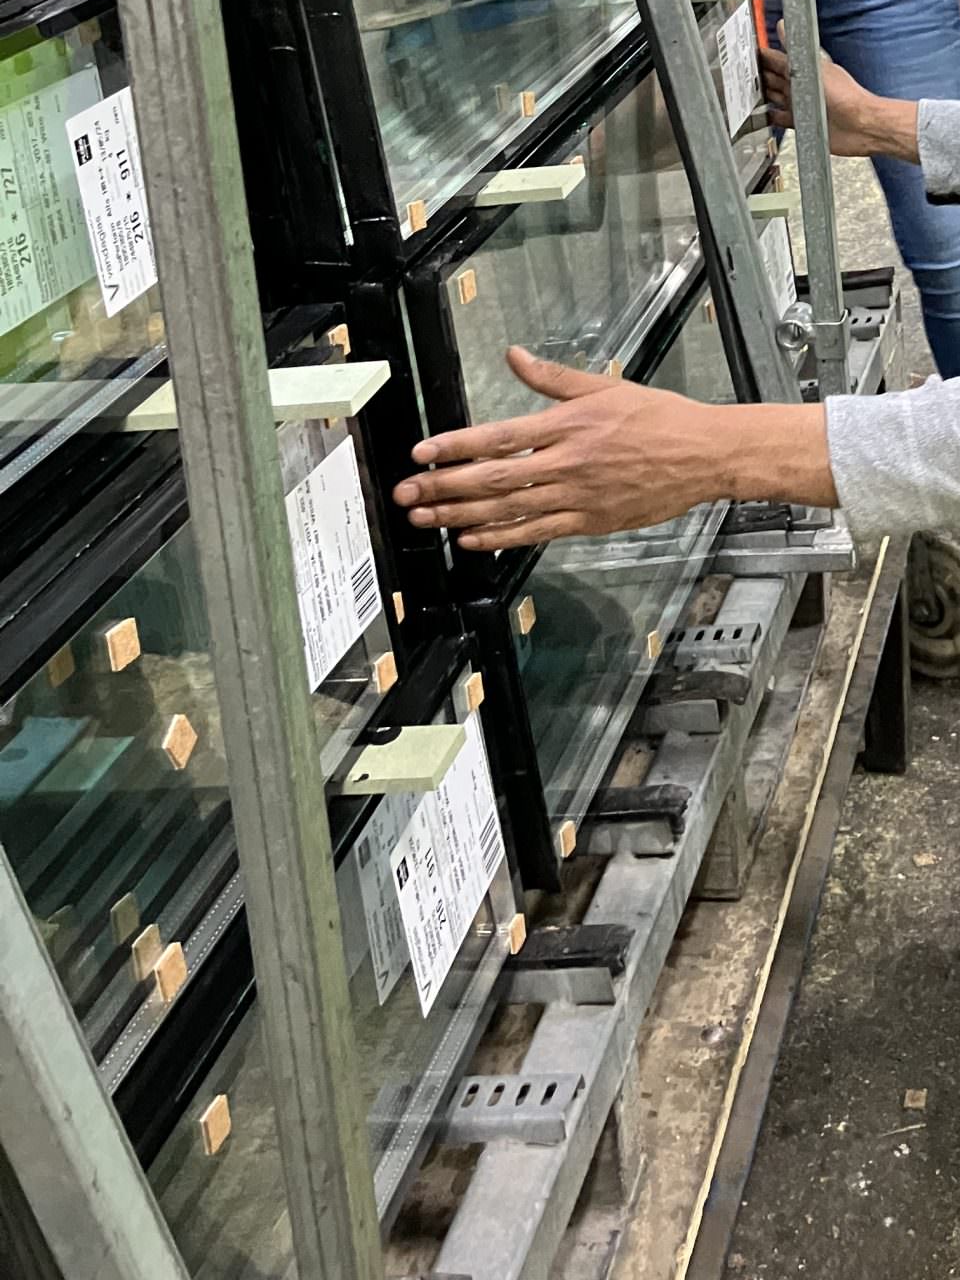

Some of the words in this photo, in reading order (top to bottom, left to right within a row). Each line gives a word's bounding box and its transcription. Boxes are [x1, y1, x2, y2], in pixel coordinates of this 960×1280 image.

[116, 148, 131, 181] 911
[1, 167, 17, 200] 727
[129, 211, 144, 245] 216
[15, 233, 32, 269] 216
[95, 215, 112, 280] vandaglas
[424, 846, 435, 878] 911
[435, 898, 446, 930] 216
